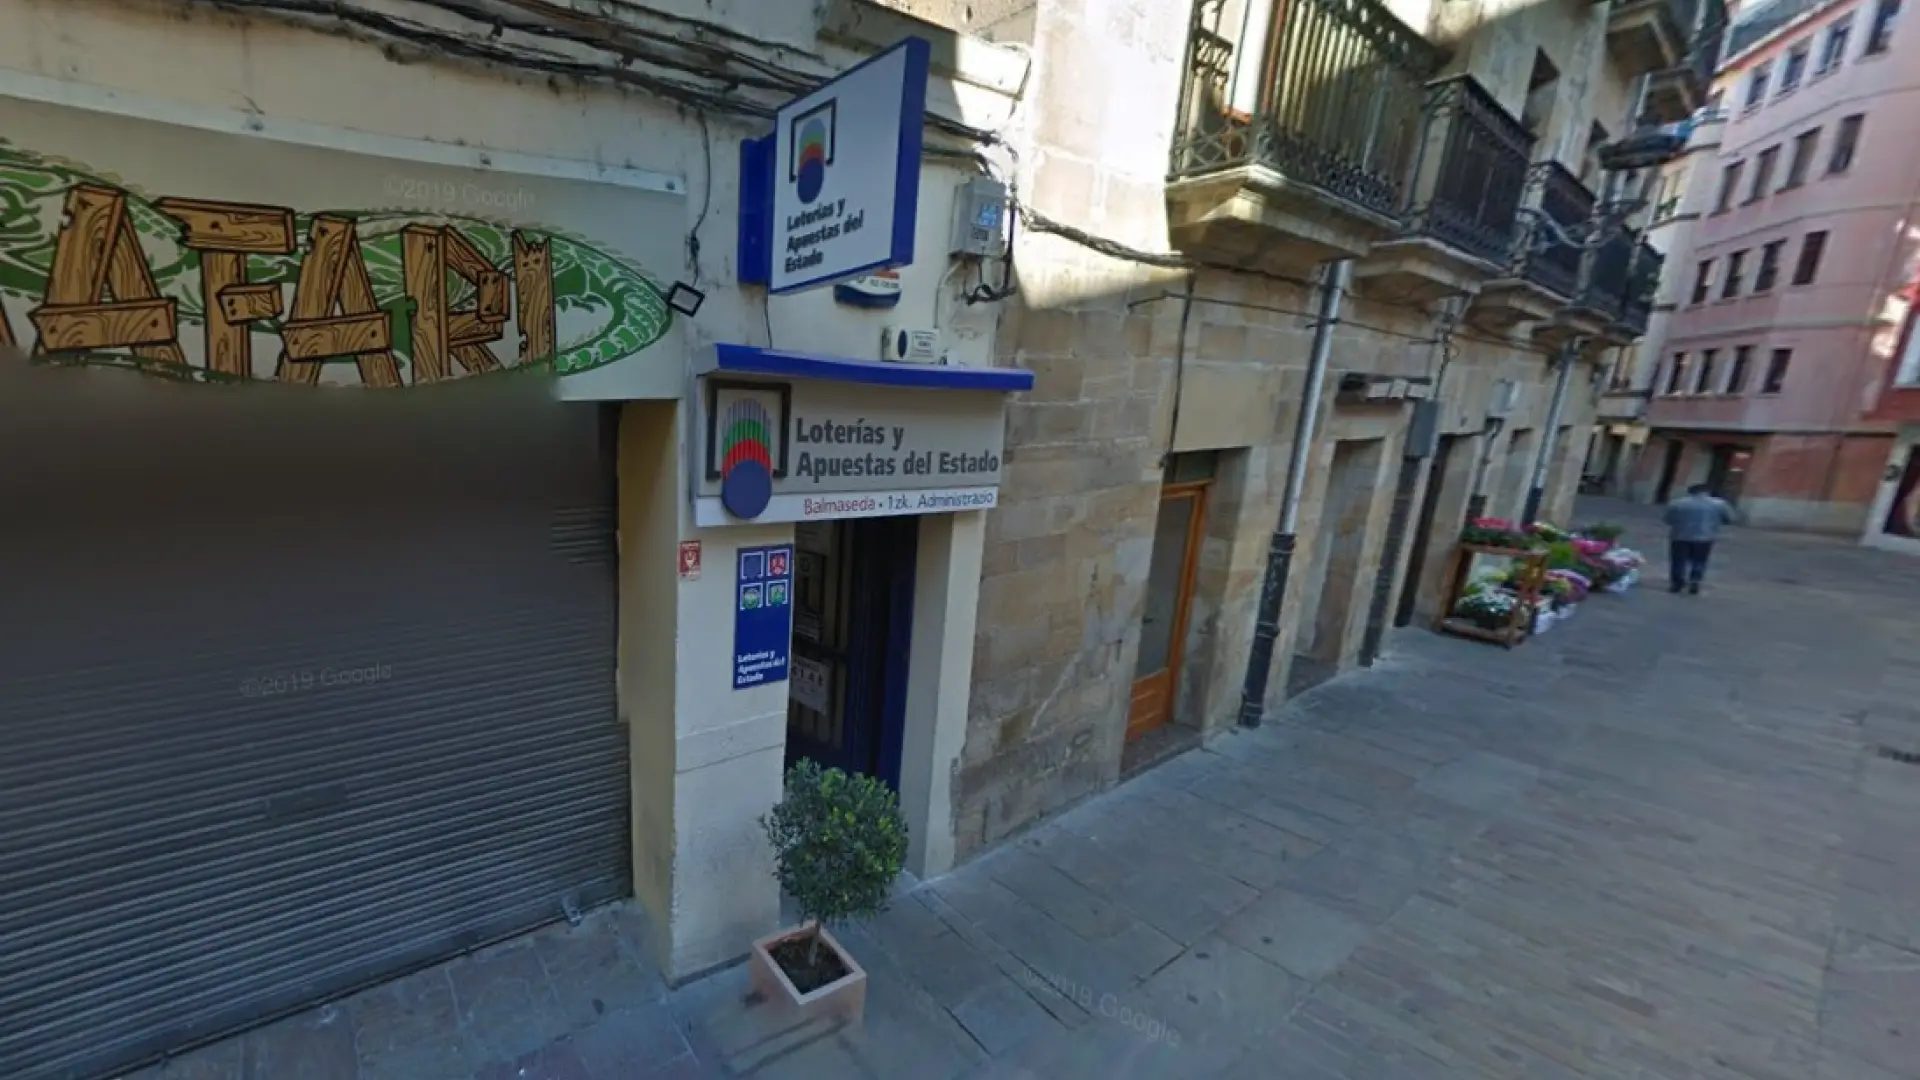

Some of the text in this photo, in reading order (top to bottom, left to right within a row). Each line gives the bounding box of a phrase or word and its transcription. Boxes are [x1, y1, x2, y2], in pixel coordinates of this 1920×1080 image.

[837, 198, 846, 218] y
[786, 209, 864, 253] Apuestas del
[785, 248, 824, 273] Estado
[796, 418, 904, 450] Loterías y
[796, 449, 999, 483] Apuestas del Estado
[804, 496, 875, 515] Balmaseda
[917, 491, 993, 509] Administrazio
